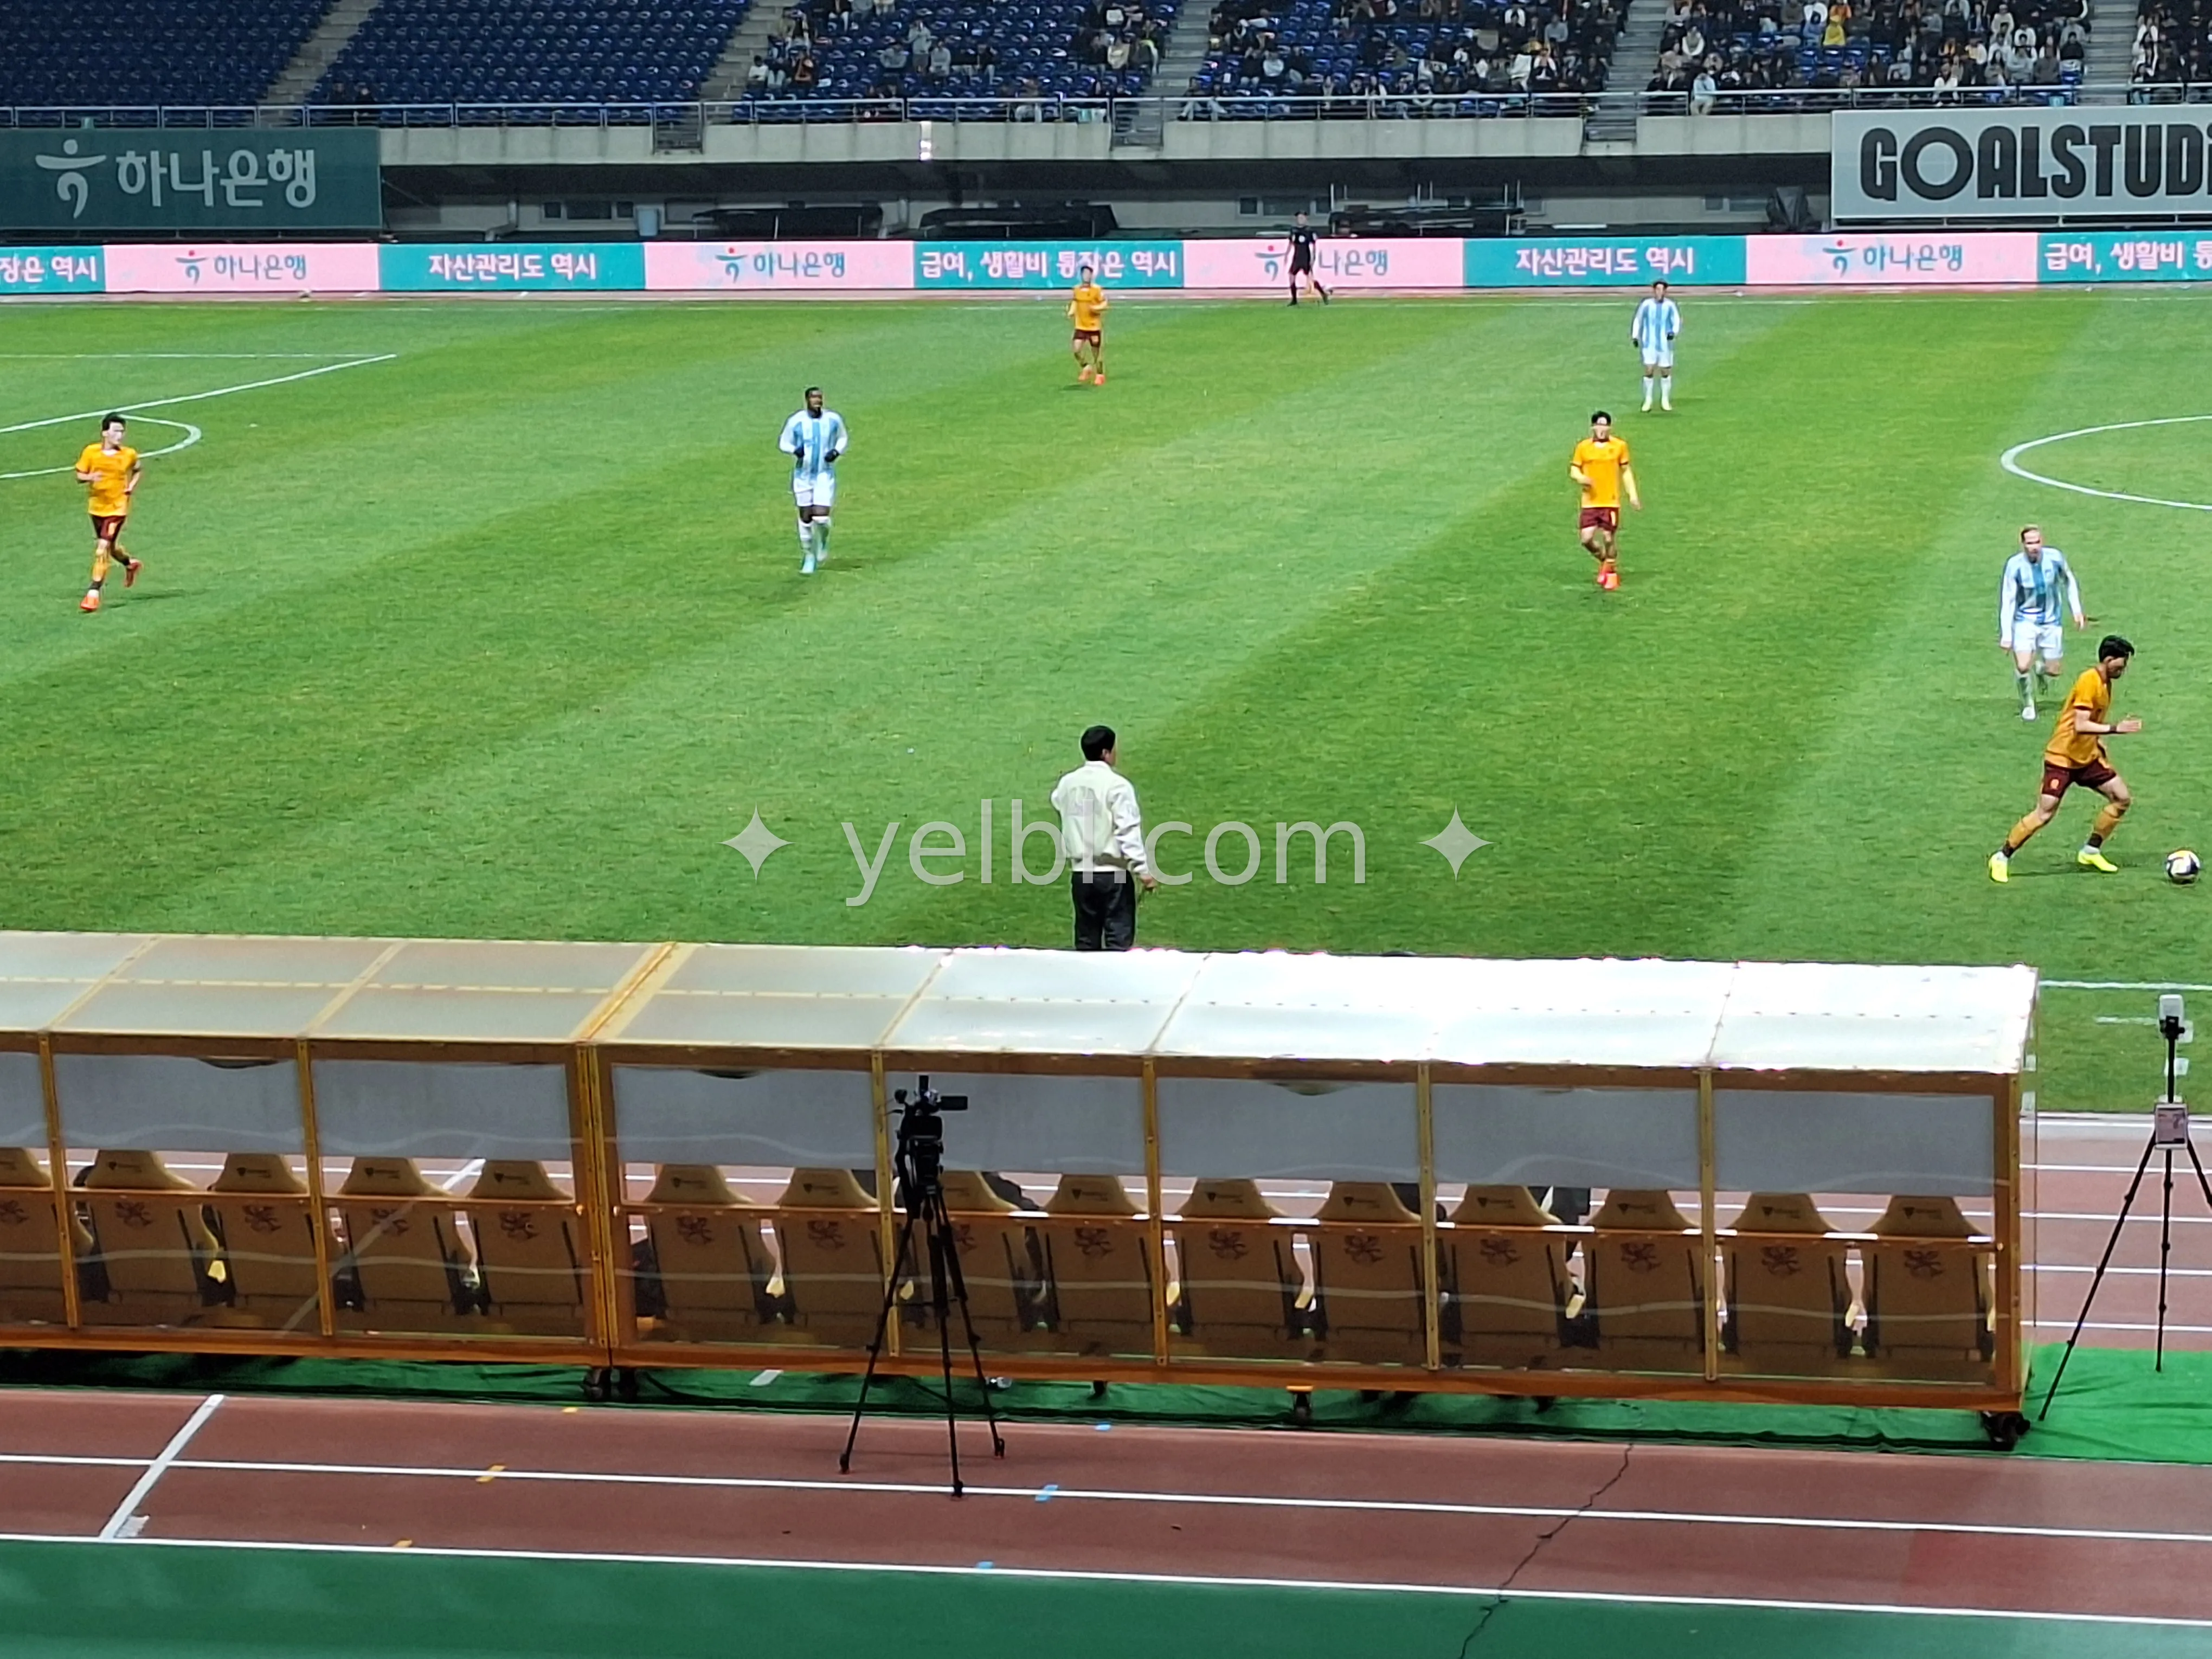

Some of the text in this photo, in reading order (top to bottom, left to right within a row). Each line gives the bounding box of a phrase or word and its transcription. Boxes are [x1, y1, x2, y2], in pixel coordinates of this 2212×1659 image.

[115, 149, 317, 208] 하나은행
[52, 255, 97, 282] 역시
[214, 254, 306, 281] 하나은행
[428, 252, 596, 281] 자산관리도 역시
[920, 251, 973, 282] 급여,
[980, 251, 1047, 279] 생활비
[1131, 250, 1175, 278] 역시
[1319, 249, 1388, 276] 나은행
[1516, 247, 1694, 276] 자산관리도 역시
[2044, 242, 2102, 275] 급여,
[2110, 241, 2183, 271] 생활비
